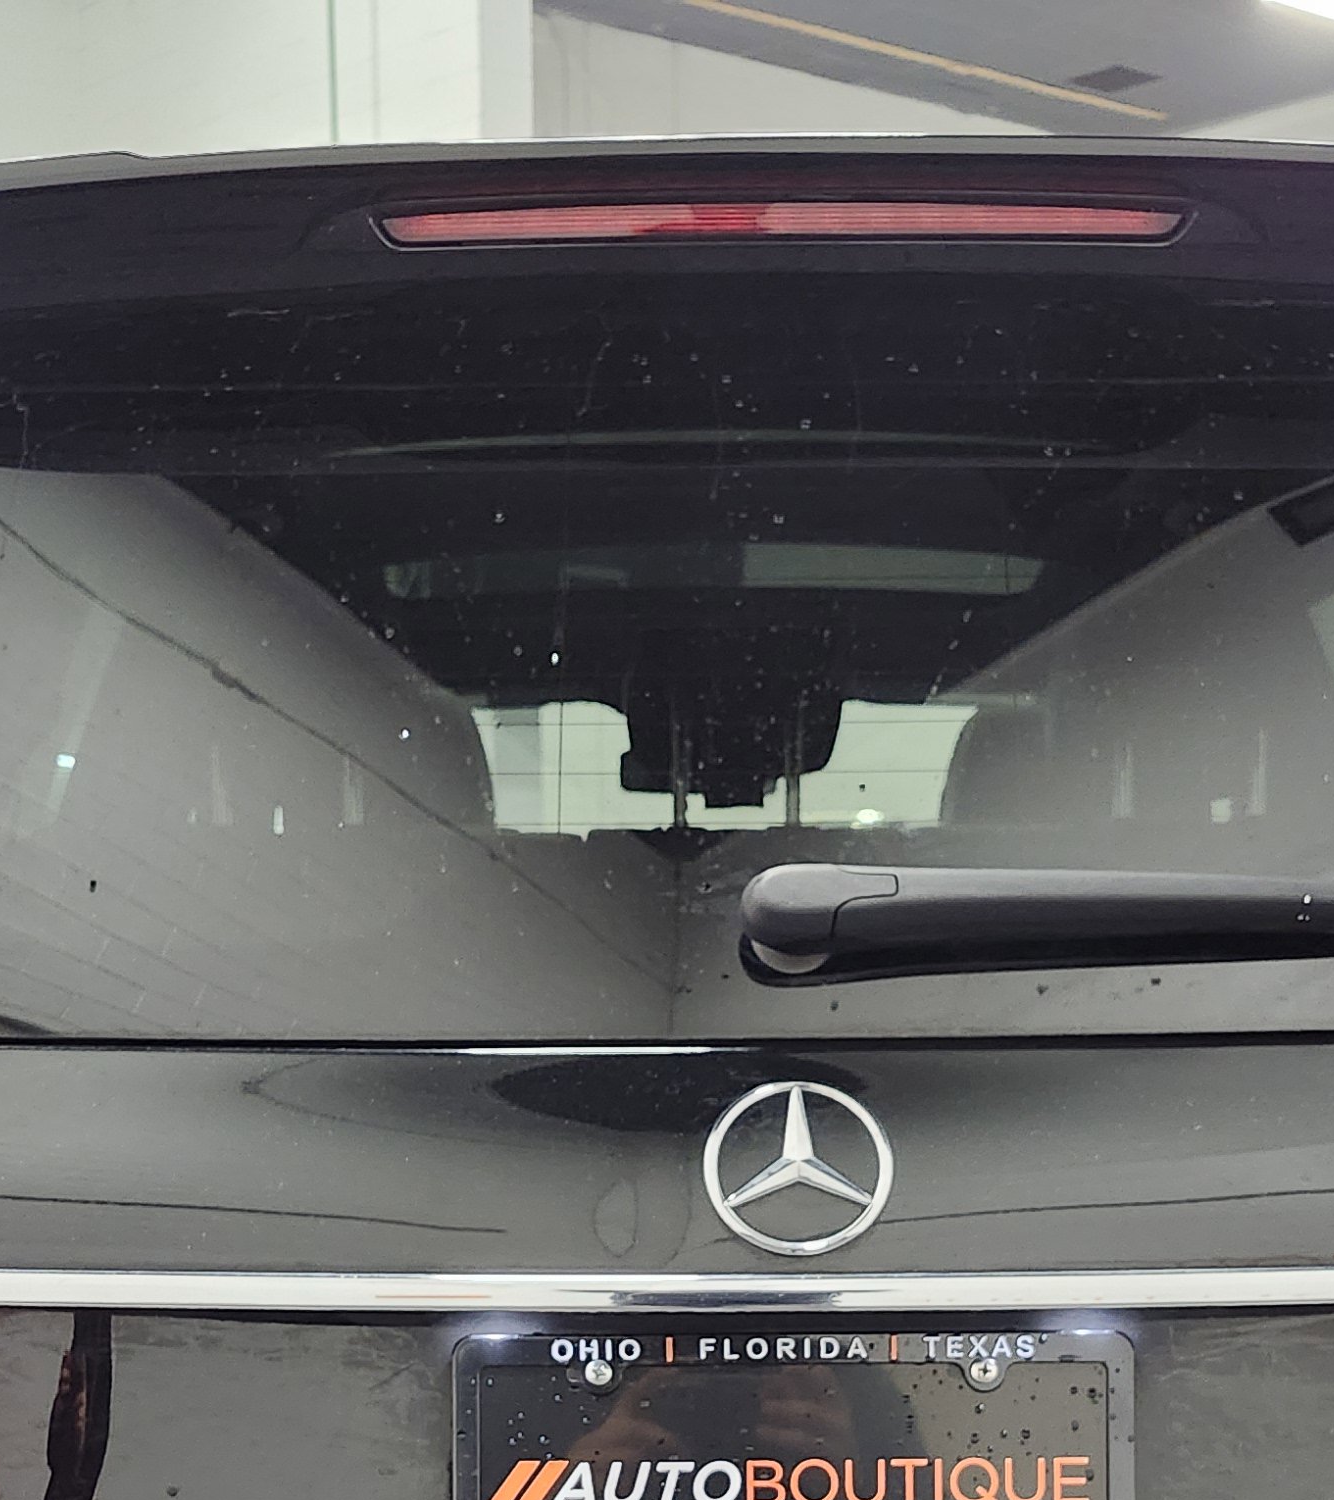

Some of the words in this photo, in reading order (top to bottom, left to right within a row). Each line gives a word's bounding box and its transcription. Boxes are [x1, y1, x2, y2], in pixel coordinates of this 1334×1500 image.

[550, 1336, 643, 1364] OHIO
[697, 1336, 870, 1362] FLORIDA
[923, 1334, 1039, 1360] TEXAS
